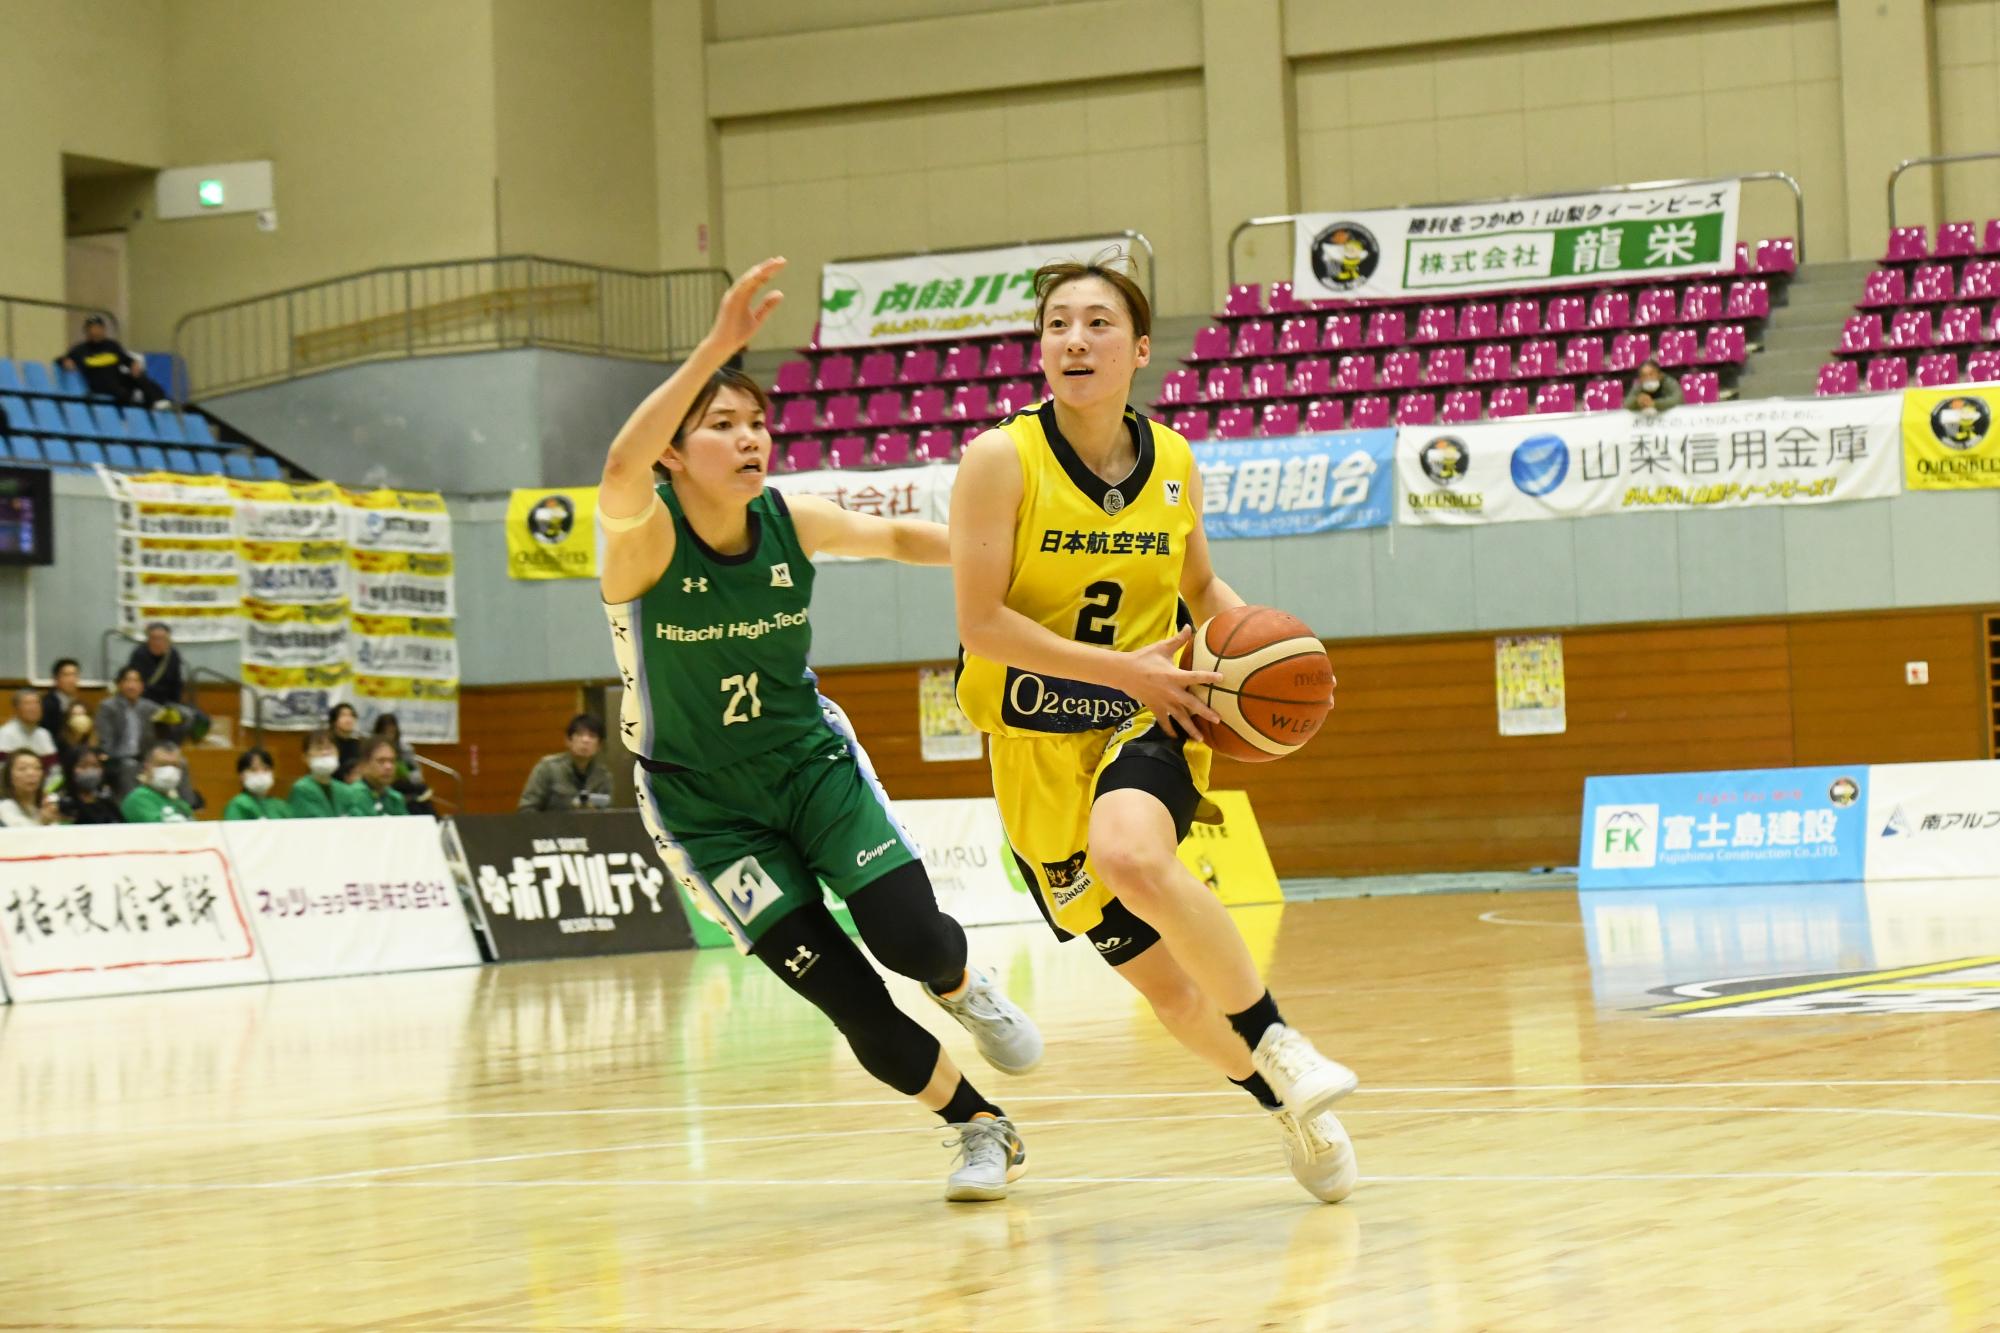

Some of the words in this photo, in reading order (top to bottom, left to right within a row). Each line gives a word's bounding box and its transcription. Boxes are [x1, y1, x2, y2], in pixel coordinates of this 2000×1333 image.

[1419, 245, 1541, 275] 株式会社
[872, 268, 1038, 316] 内藤ハウ
[1582, 425, 1870, 481] 山梨信用金庫
[1917, 458, 2000, 474] QUEENBEE
[1040, 529, 1170, 556] 日本航空学園
[1073, 578, 1126, 648] 2
[656, 622, 723, 642] Hitachi
[721, 672, 762, 726] 21
[1663, 808, 1837, 850] 富士島建設
[857, 839, 896, 867] Cougars
